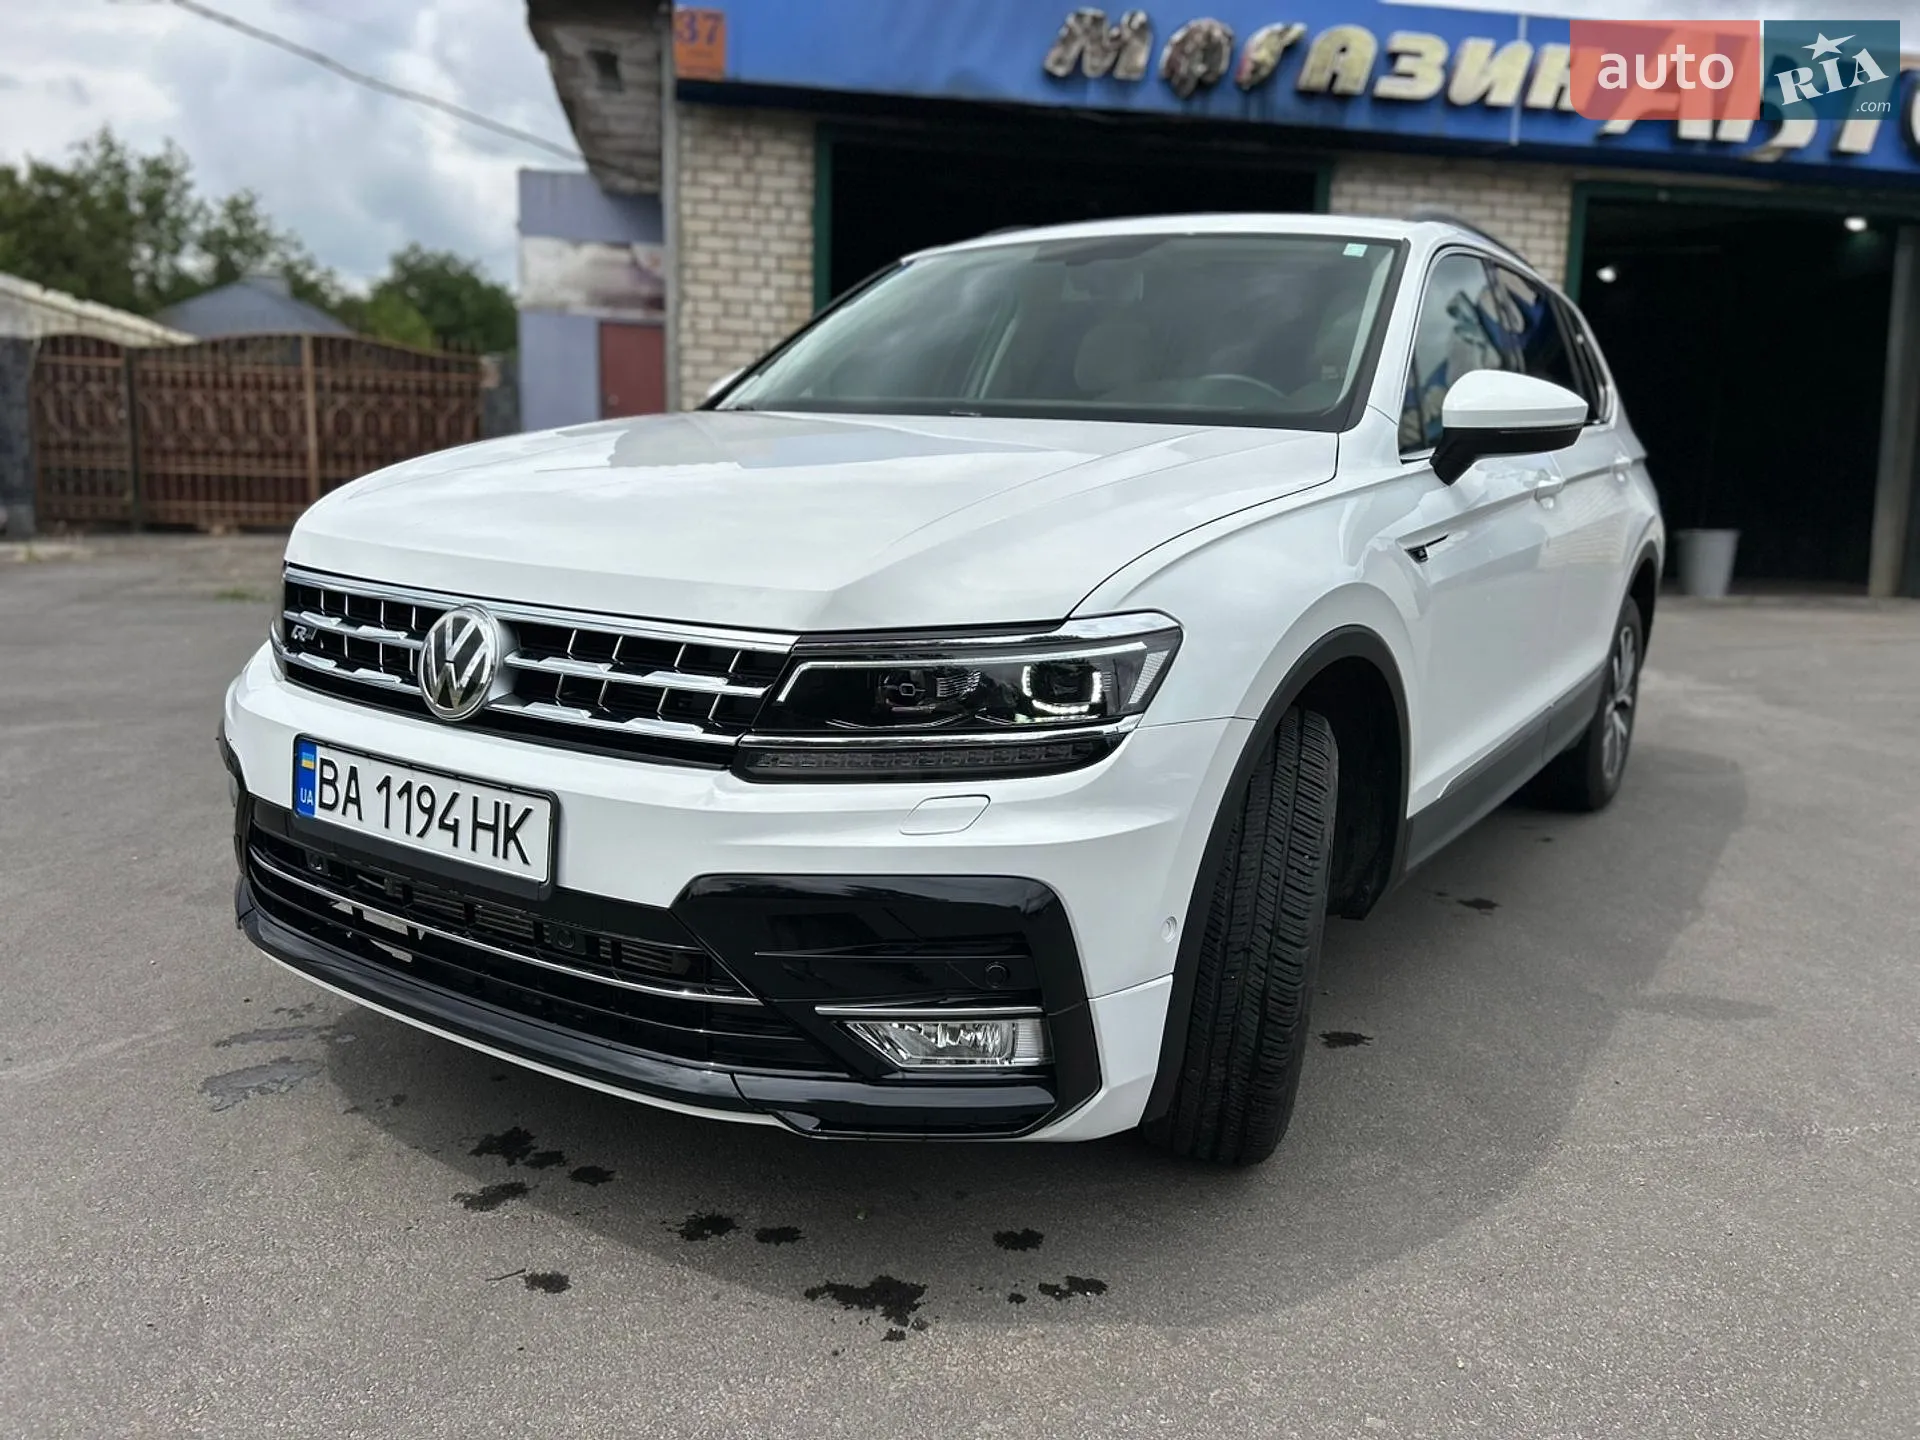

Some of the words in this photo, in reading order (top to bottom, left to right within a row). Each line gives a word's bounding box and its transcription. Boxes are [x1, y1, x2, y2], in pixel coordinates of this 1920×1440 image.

[674, 10, 724, 47] 37
[300, 787, 314, 806] UA
[319, 757, 364, 822] BA
[375, 774, 461, 848] 1194
[471, 795, 534, 866] HK
